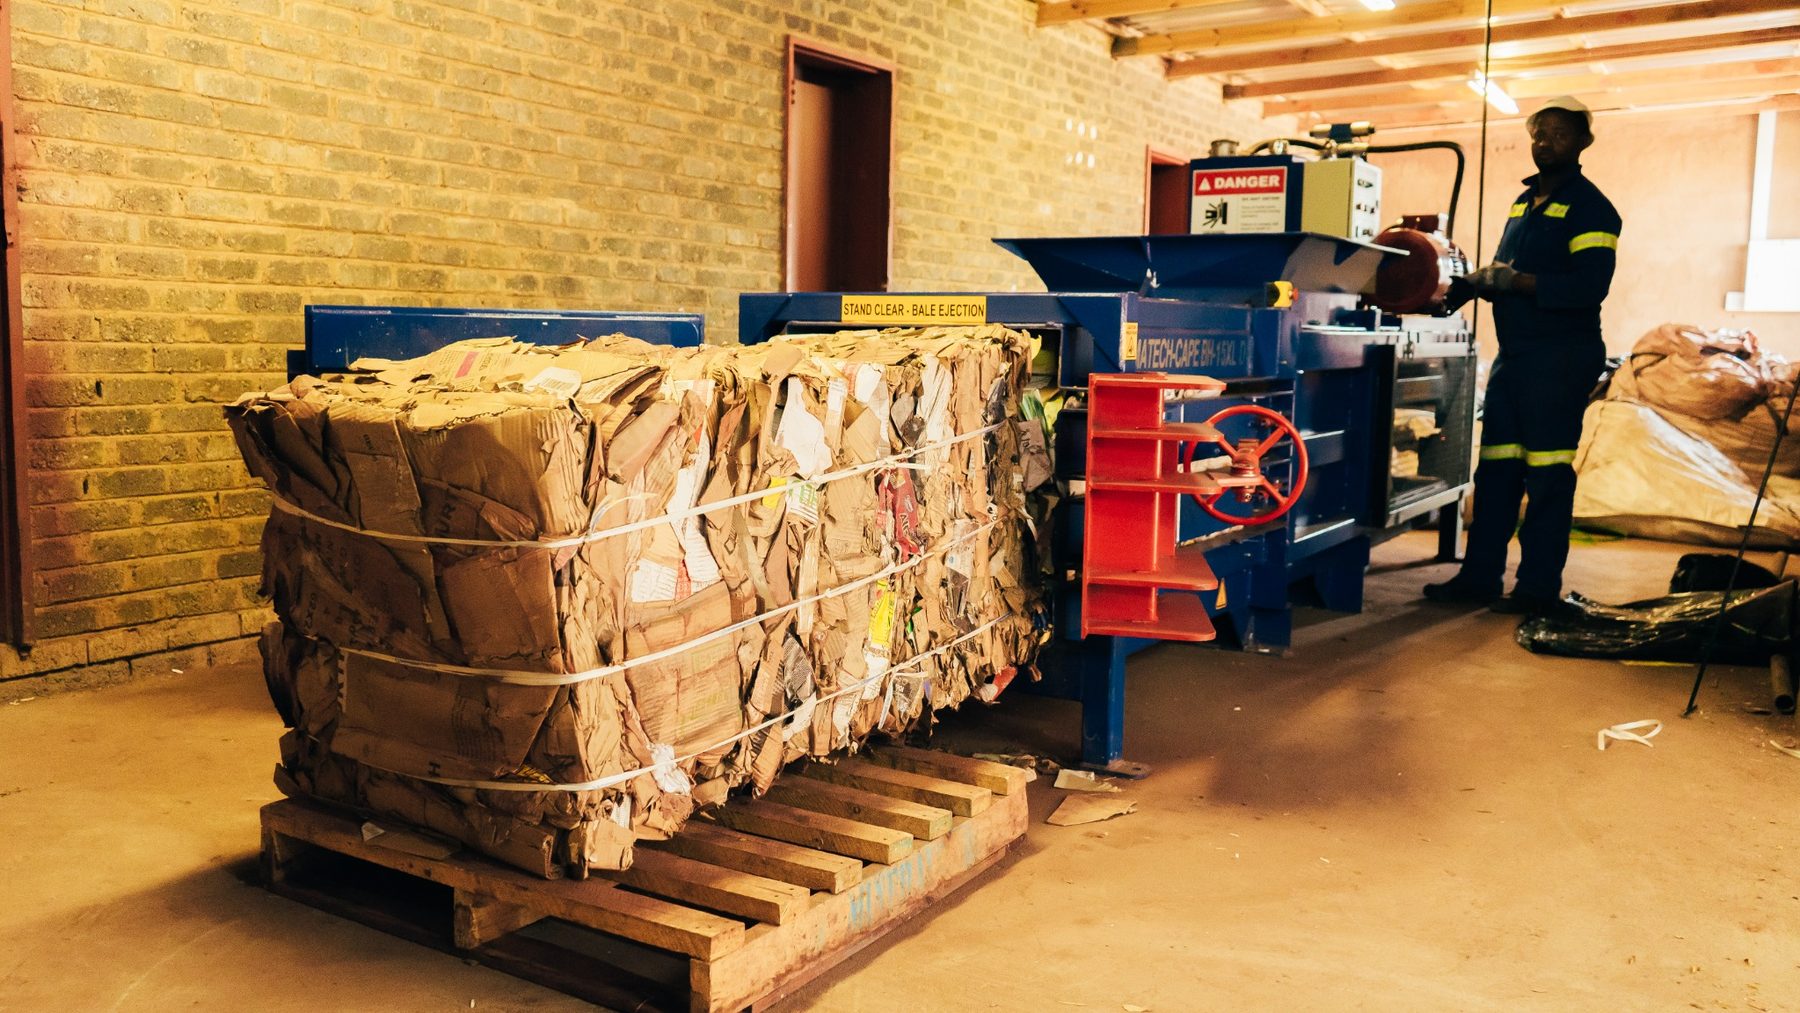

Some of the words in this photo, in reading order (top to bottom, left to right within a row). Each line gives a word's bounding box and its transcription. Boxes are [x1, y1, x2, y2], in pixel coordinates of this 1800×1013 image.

[1214, 175, 1280, 189] DANGER
[844, 303, 872, 315] STAND
[874, 304, 904, 316] CLEAR
[912, 304, 936, 316] BALE
[939, 304, 985, 317] EJECTION
